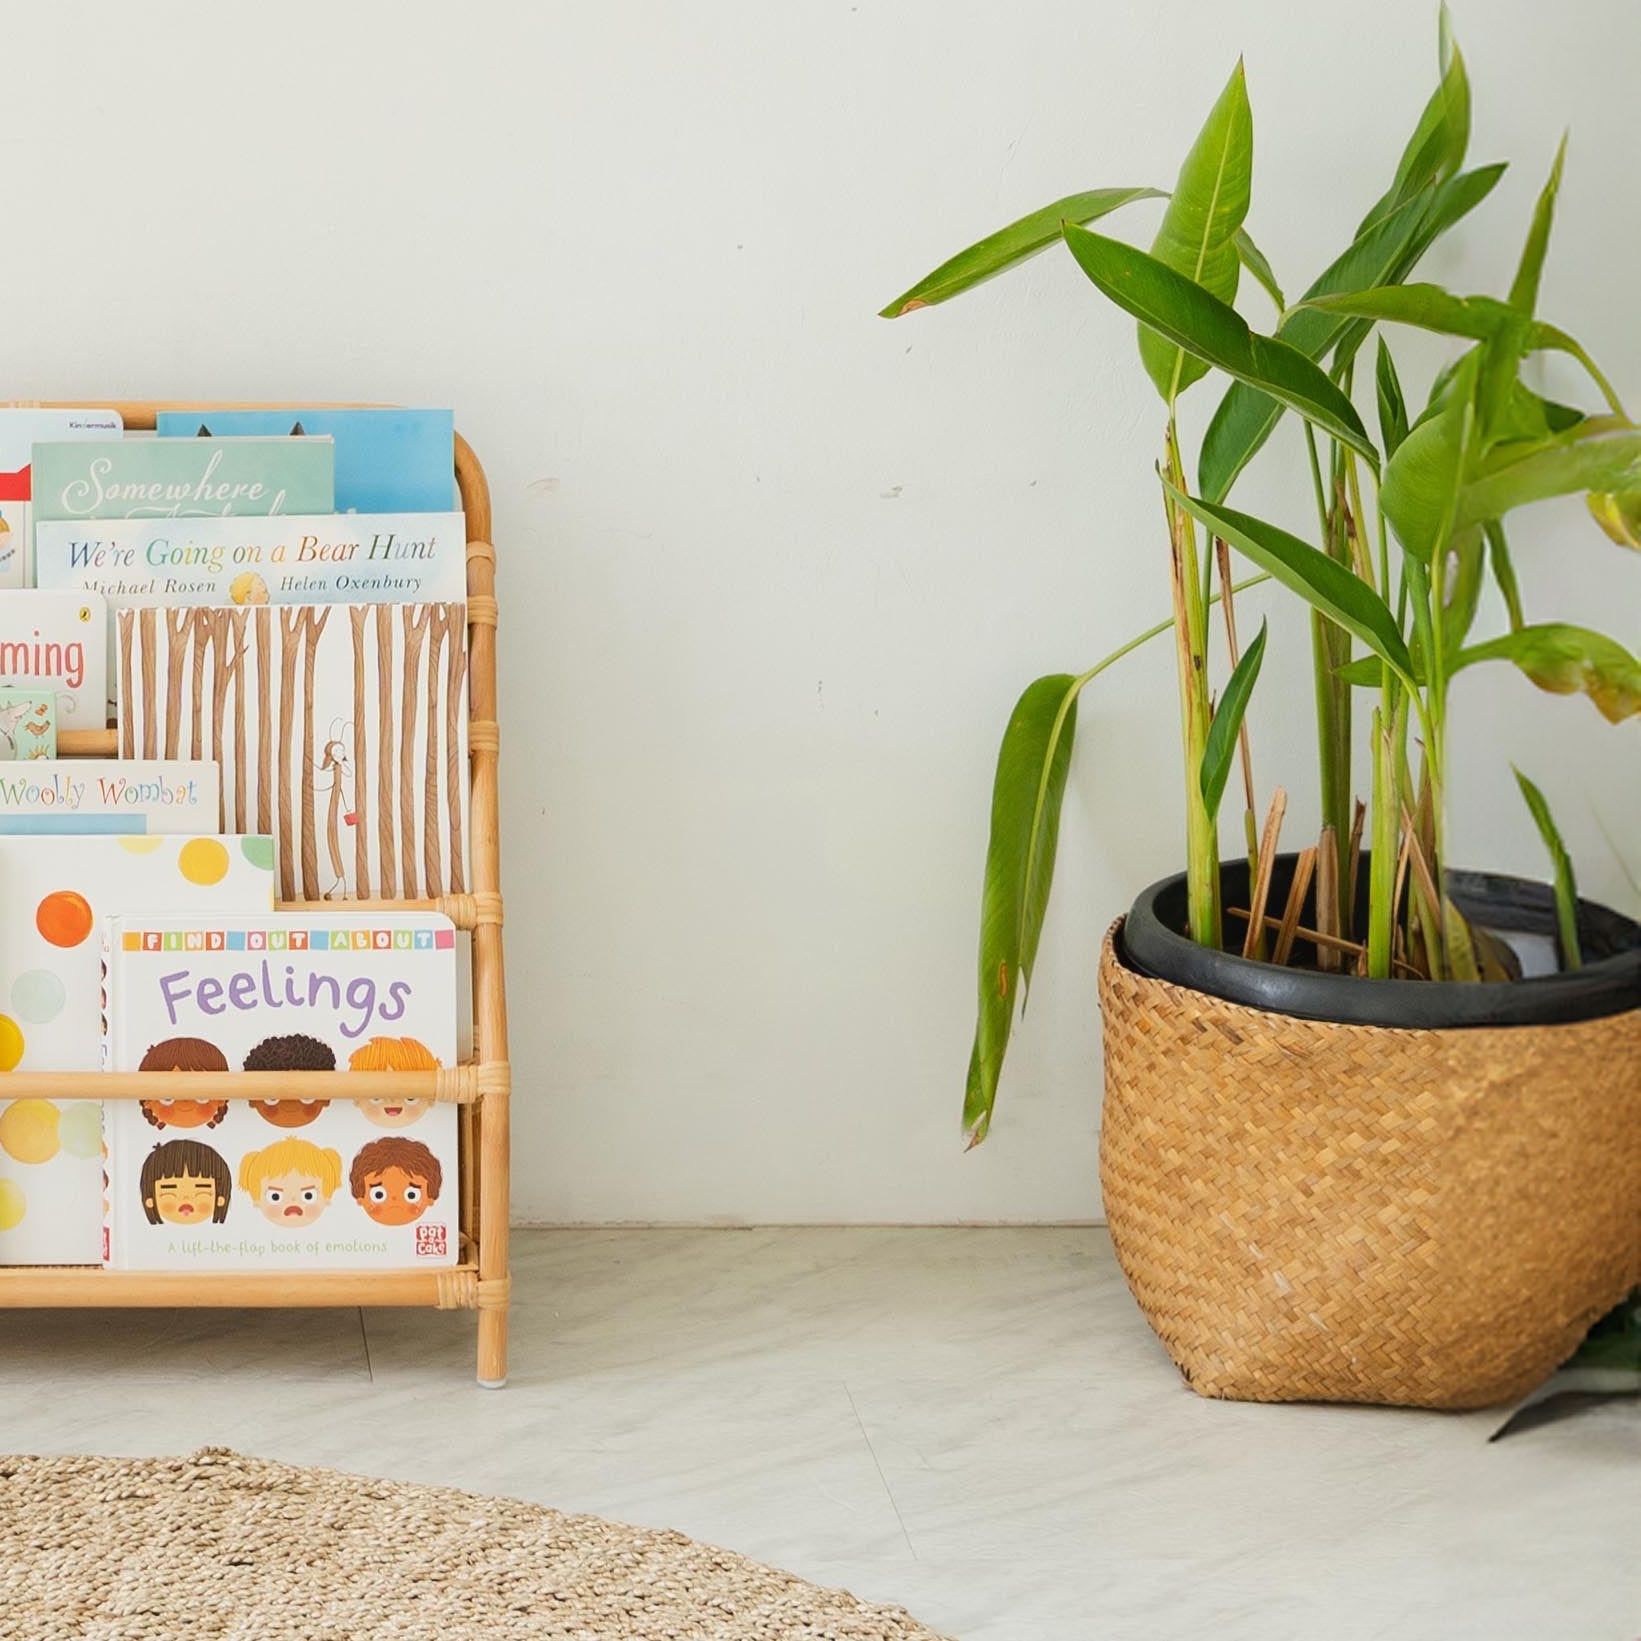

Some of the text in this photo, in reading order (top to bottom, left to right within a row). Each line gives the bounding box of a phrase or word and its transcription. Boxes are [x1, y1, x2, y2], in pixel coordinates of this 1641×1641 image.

[62, 449, 269, 514] Somewhere
[69, 534, 437, 573] We're Going on a Bear Hunt
[83, 578, 216, 595] Michael Rosen
[281, 575, 423, 593] Helen Oxenbury
[97, 775, 198, 805] Wombat
[147, 933, 431, 949] FIND OUT ABOUT
[160, 959, 411, 1038] Feelings
[168, 1240, 388, 1256] A lift-the-flap book of emotions
